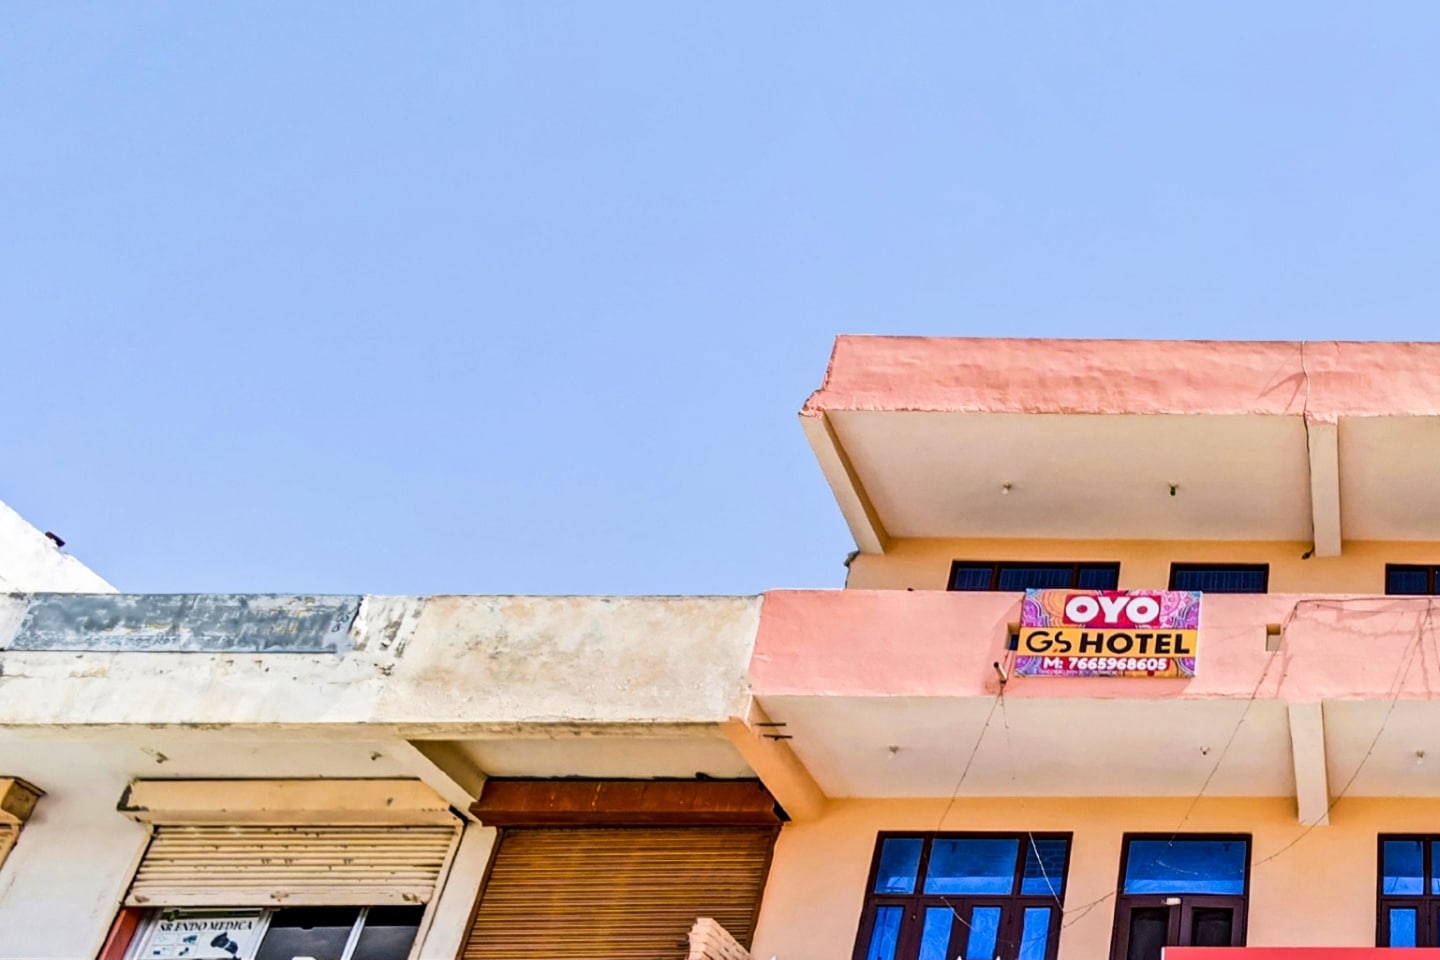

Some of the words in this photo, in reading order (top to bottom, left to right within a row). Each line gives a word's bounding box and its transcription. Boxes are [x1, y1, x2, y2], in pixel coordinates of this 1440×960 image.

[1065, 595, 1160, 624] OYO
[1078, 632, 1190, 655] HOTEL
[1068, 657, 1168, 670] 7665968605
